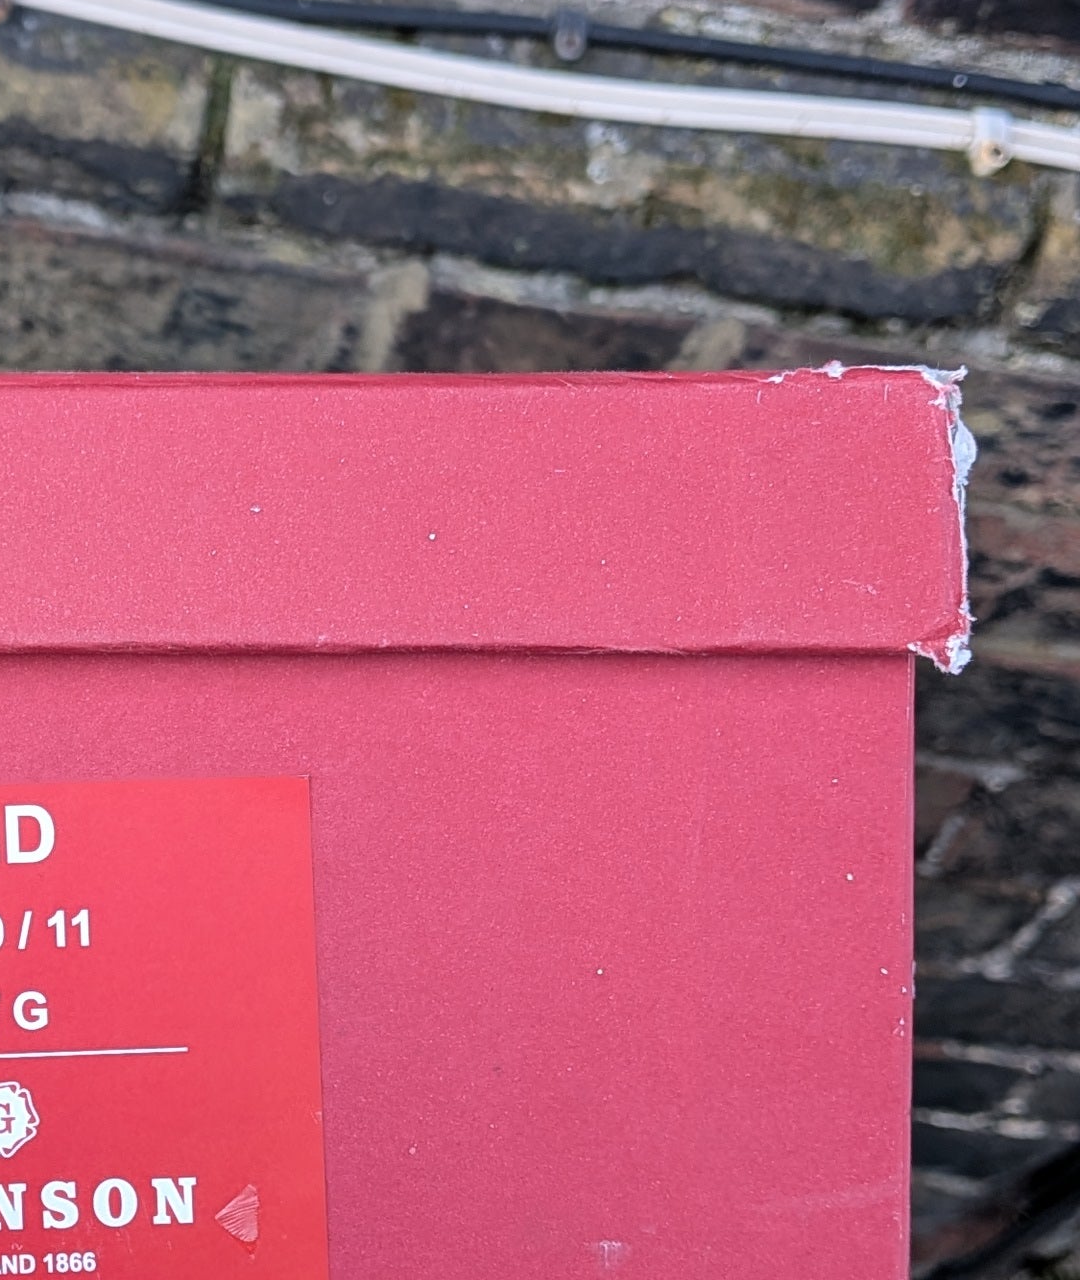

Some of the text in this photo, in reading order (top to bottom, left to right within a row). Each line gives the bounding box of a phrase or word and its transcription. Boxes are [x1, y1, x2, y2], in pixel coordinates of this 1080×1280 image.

[47, 908, 90, 948] 11
[12, 990, 49, 1031] G
[42, 1251, 97, 1274] 1866
